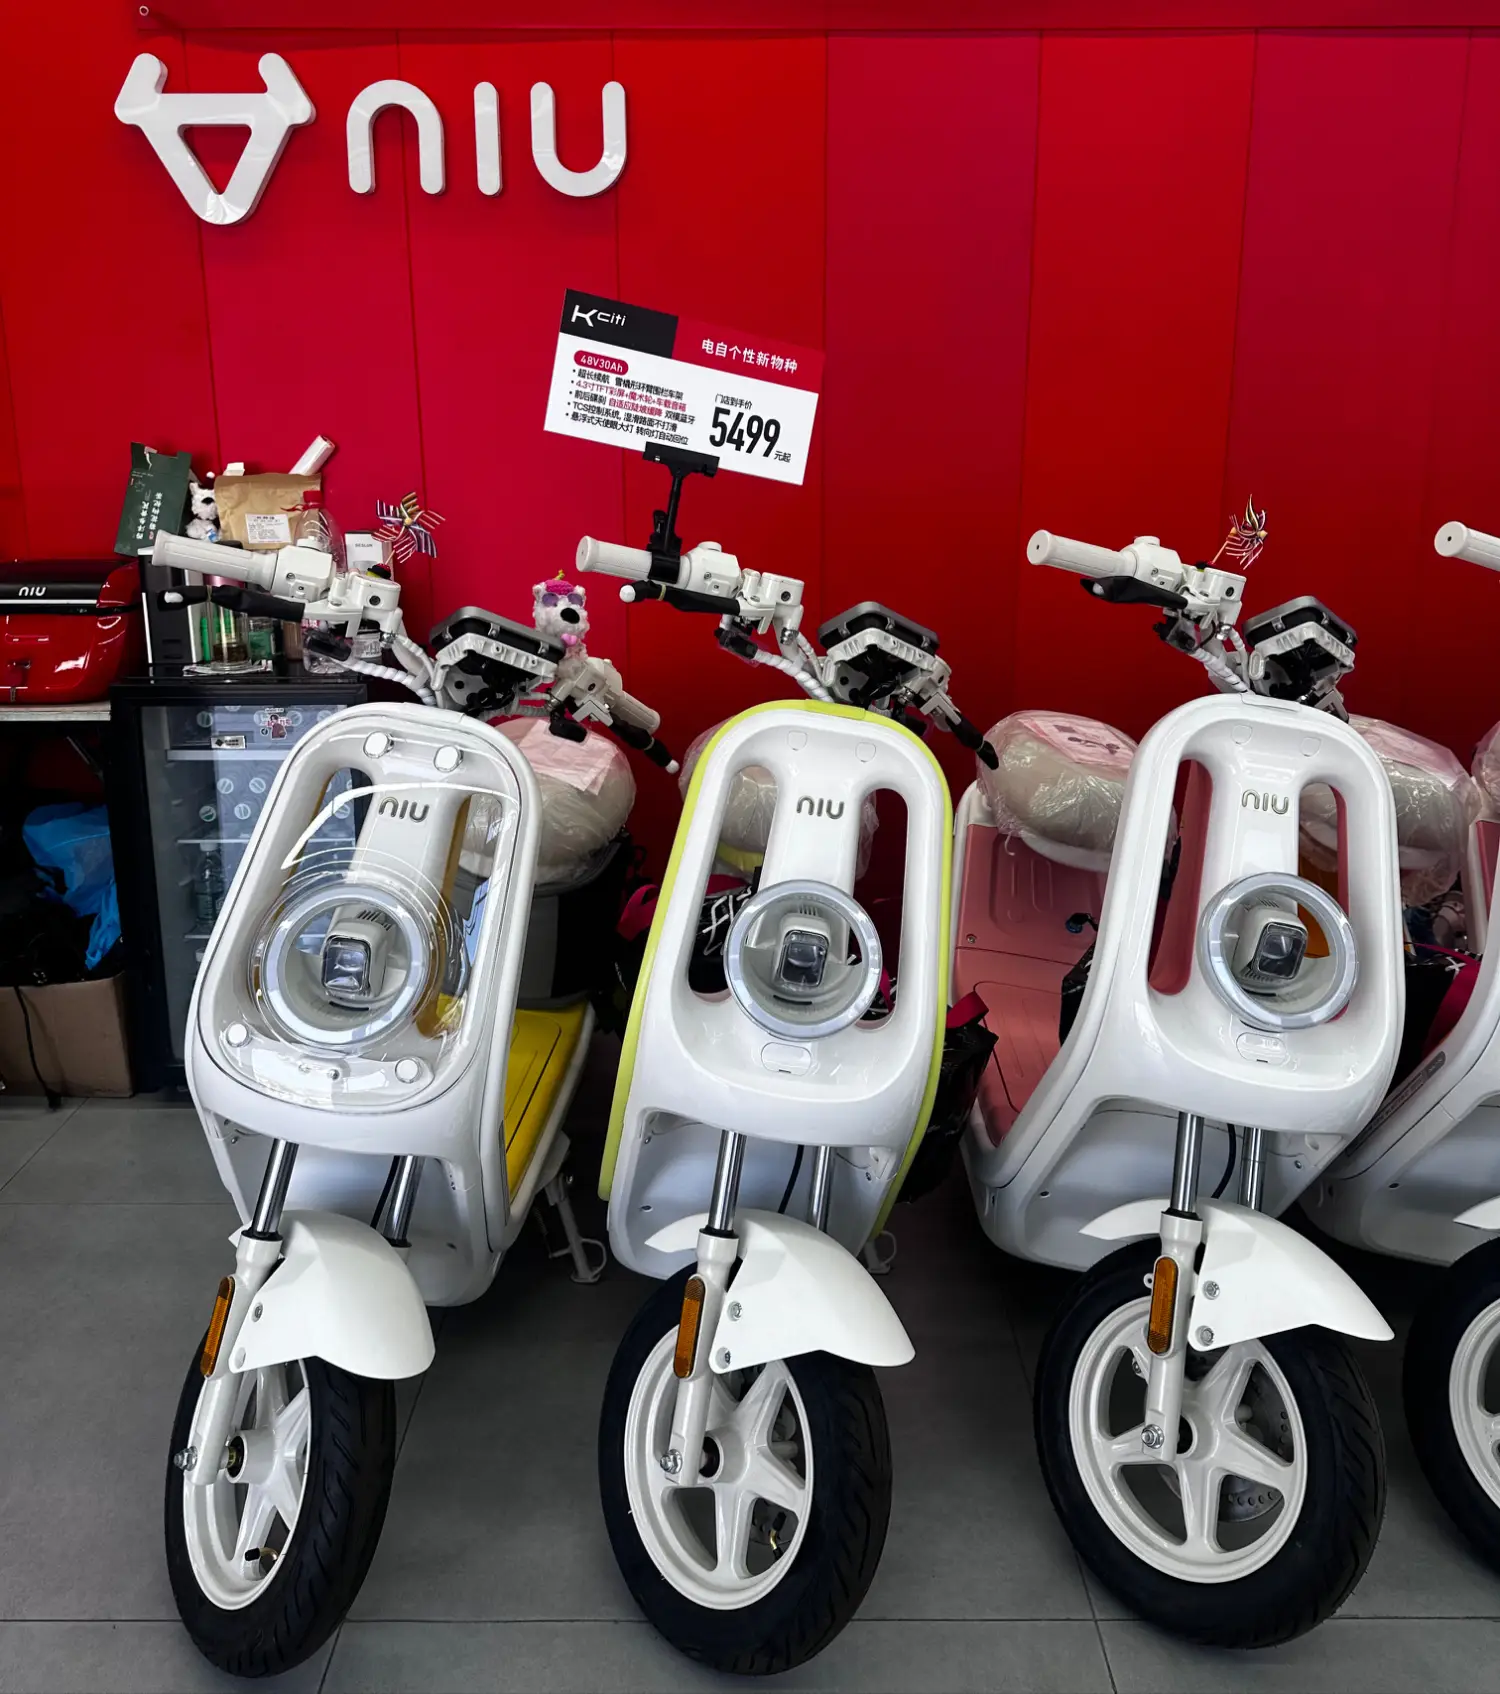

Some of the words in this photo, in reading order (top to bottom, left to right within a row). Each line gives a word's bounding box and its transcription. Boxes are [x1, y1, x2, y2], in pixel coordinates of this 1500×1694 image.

[580, 354, 623, 373] 48V30Ah
[701, 338, 798, 374] 电自个性新物种
[577, 368, 610, 385] 超长续航
[714, 393, 753, 410] 门店到手价
[664, 410, 696, 425] 双模蓝牙
[571, 411, 634, 434] 悬浮式天使眼大灯
[635, 426, 689, 445] 转向灯自动回位
[709, 406, 781, 458] 5499
[773, 450, 791, 463] 元起
